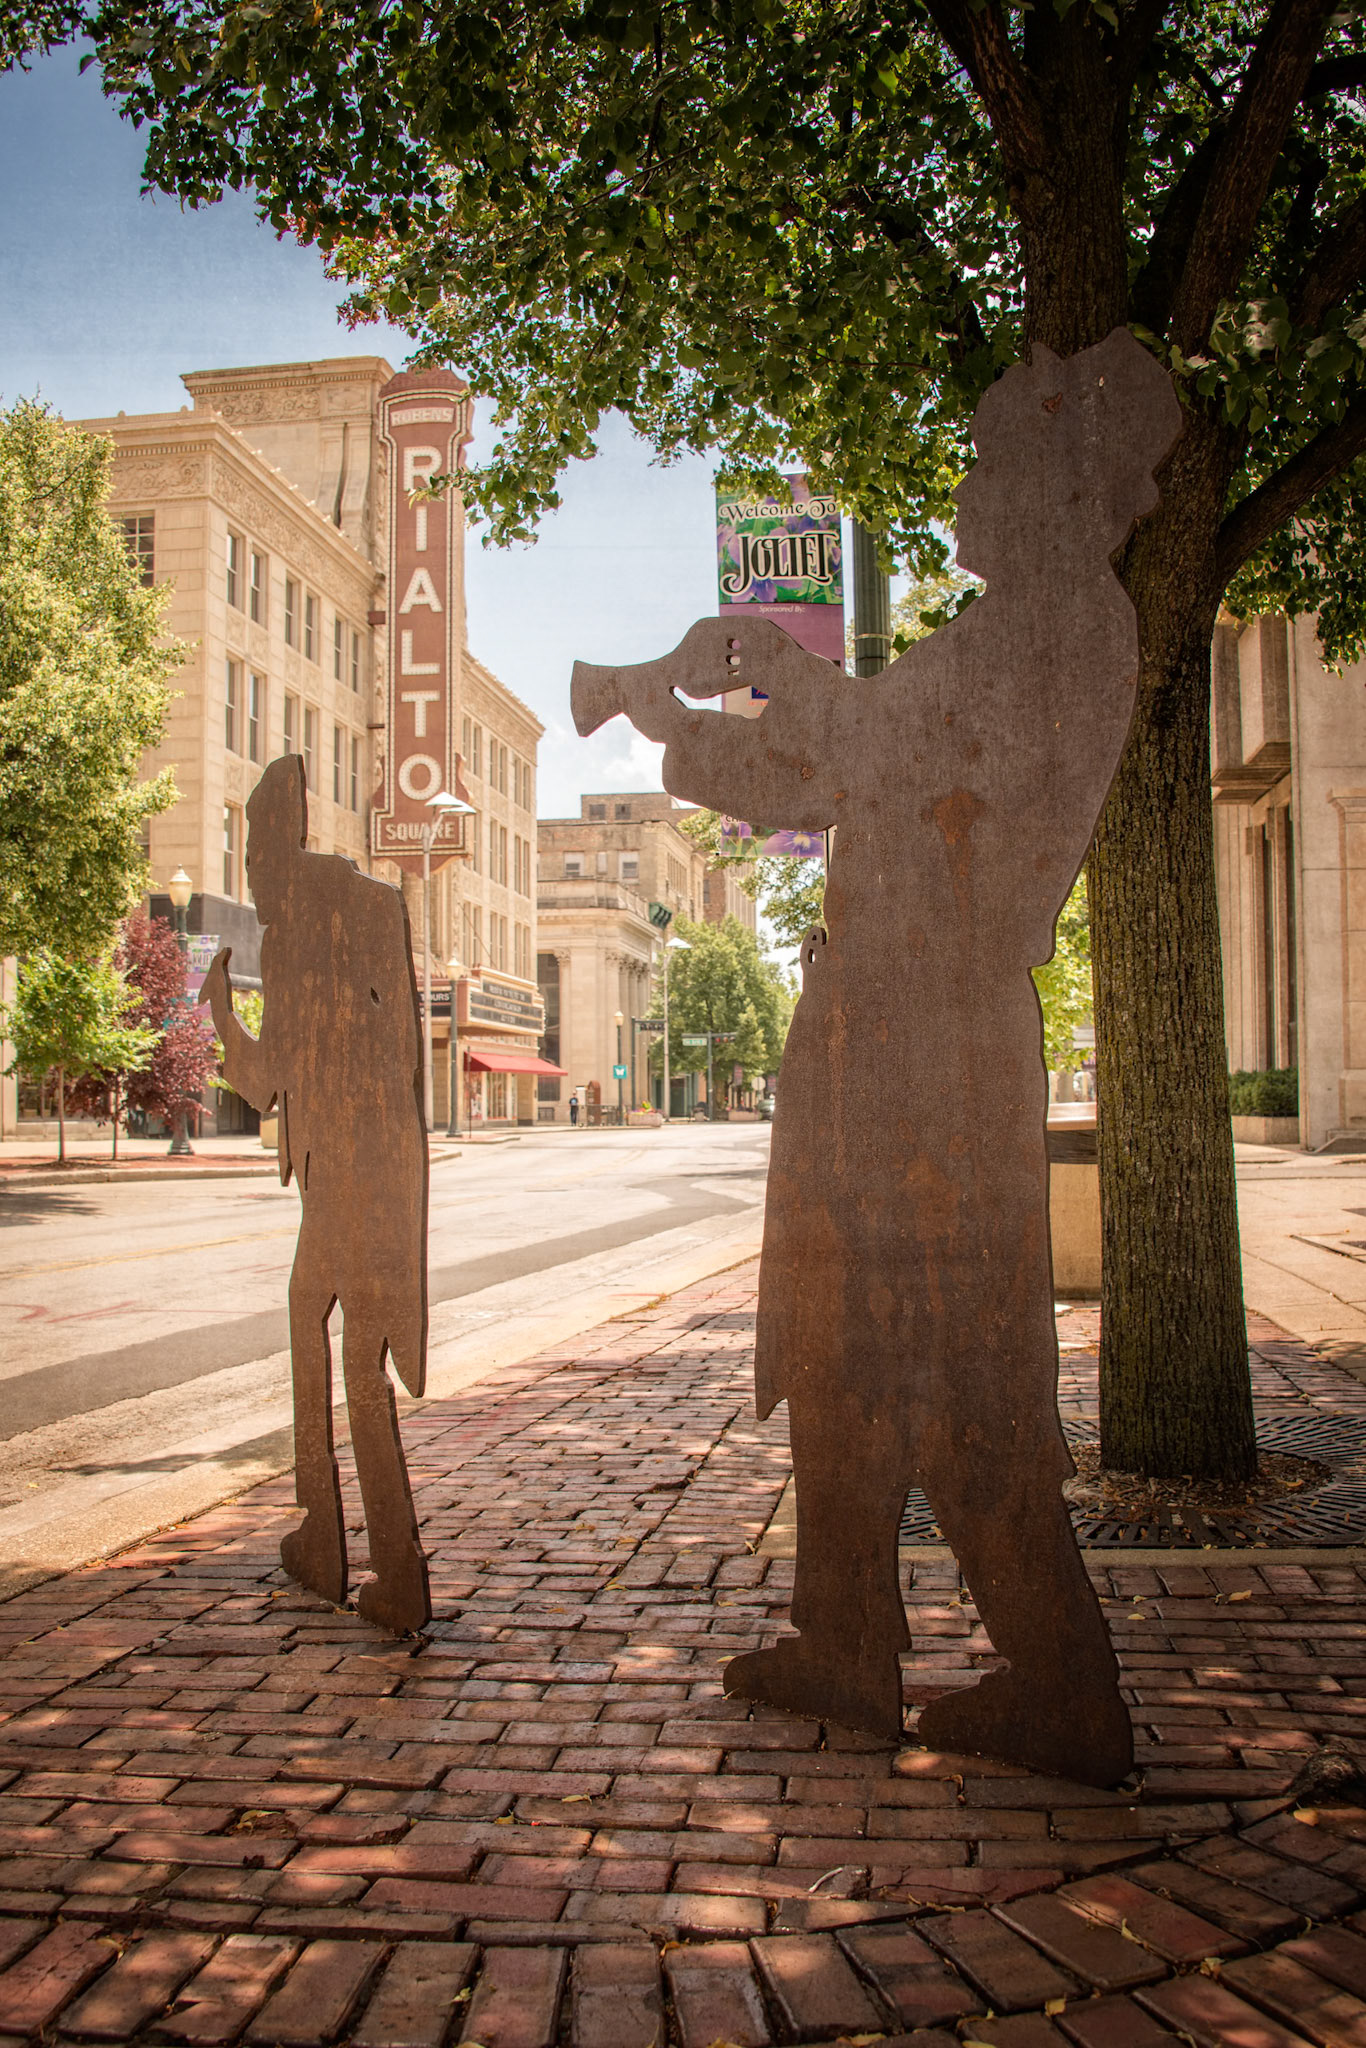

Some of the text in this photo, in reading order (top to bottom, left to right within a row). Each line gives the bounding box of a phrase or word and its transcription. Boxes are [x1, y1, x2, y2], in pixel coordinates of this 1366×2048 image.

[719, 495, 837, 521] Welcome To
[721, 531, 839, 594] JOLIET
[398, 445, 443, 800] RIALTO
